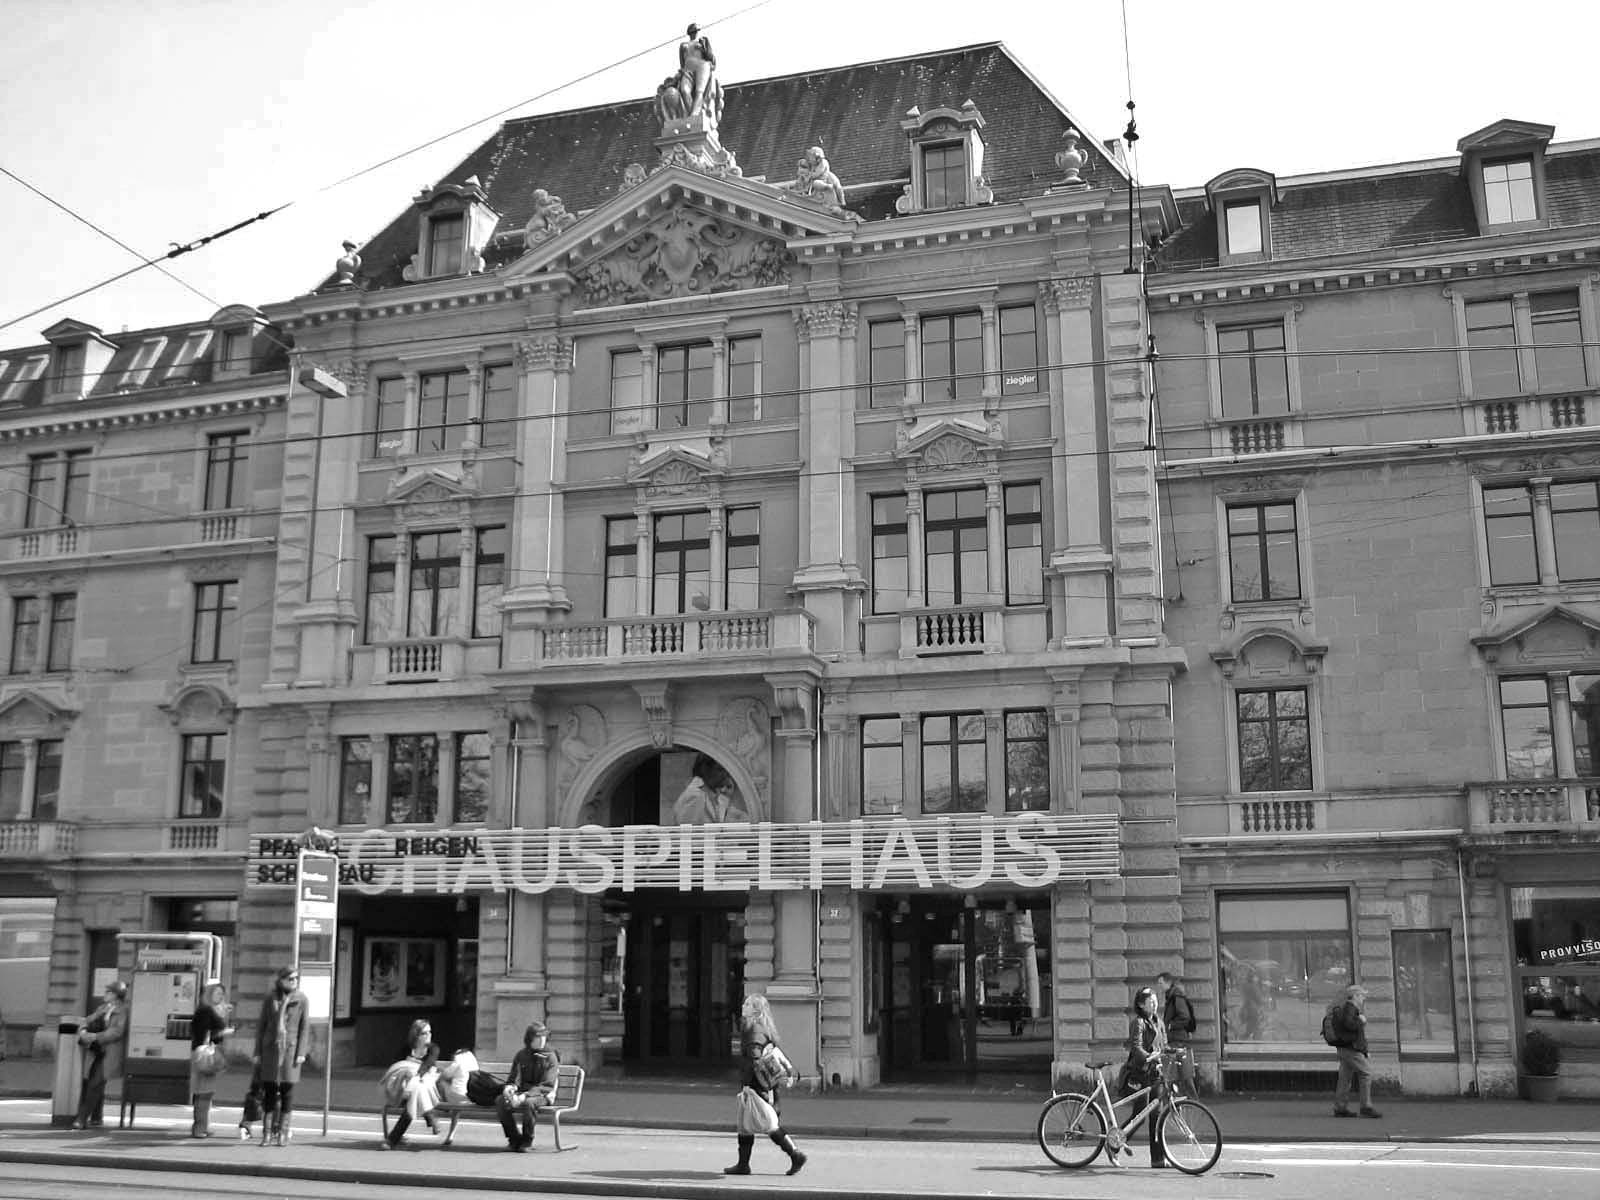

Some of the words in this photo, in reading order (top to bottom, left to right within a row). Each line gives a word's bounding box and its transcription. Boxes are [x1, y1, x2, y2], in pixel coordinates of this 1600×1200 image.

[300, 812, 1061, 895] CHAUSPIELHAUS
[395, 836, 477, 856] REIGEN
[257, 863, 374, 883] SCHAU
[1540, 940, 1600, 960] PROVVISO
